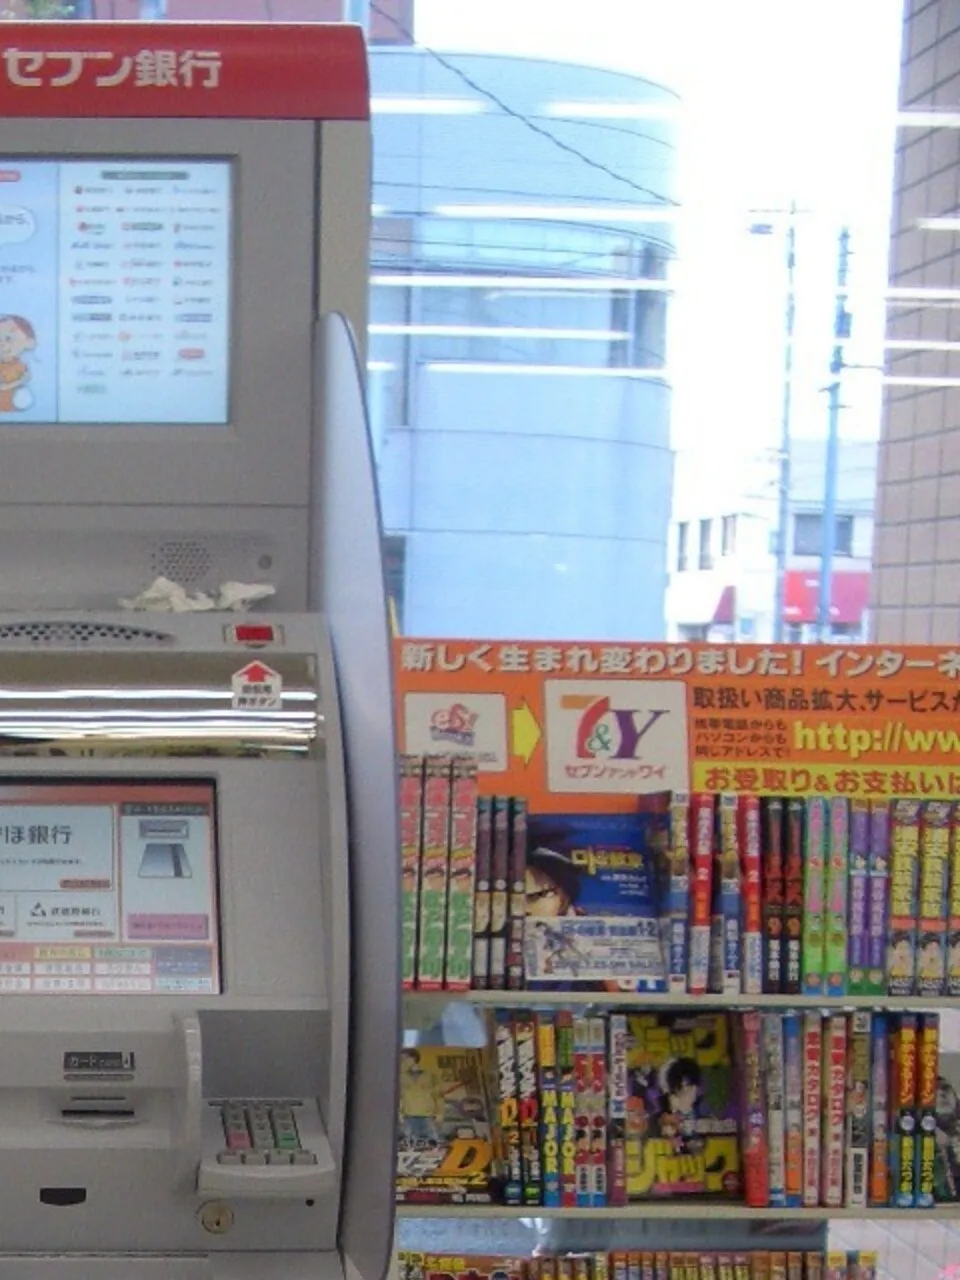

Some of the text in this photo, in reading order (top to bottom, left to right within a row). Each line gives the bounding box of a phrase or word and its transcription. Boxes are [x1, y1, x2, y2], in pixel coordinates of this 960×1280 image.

[2, 47, 223, 88] セブン銀行
[693, 686, 960, 713] 取扱い商品拡大、サービス
